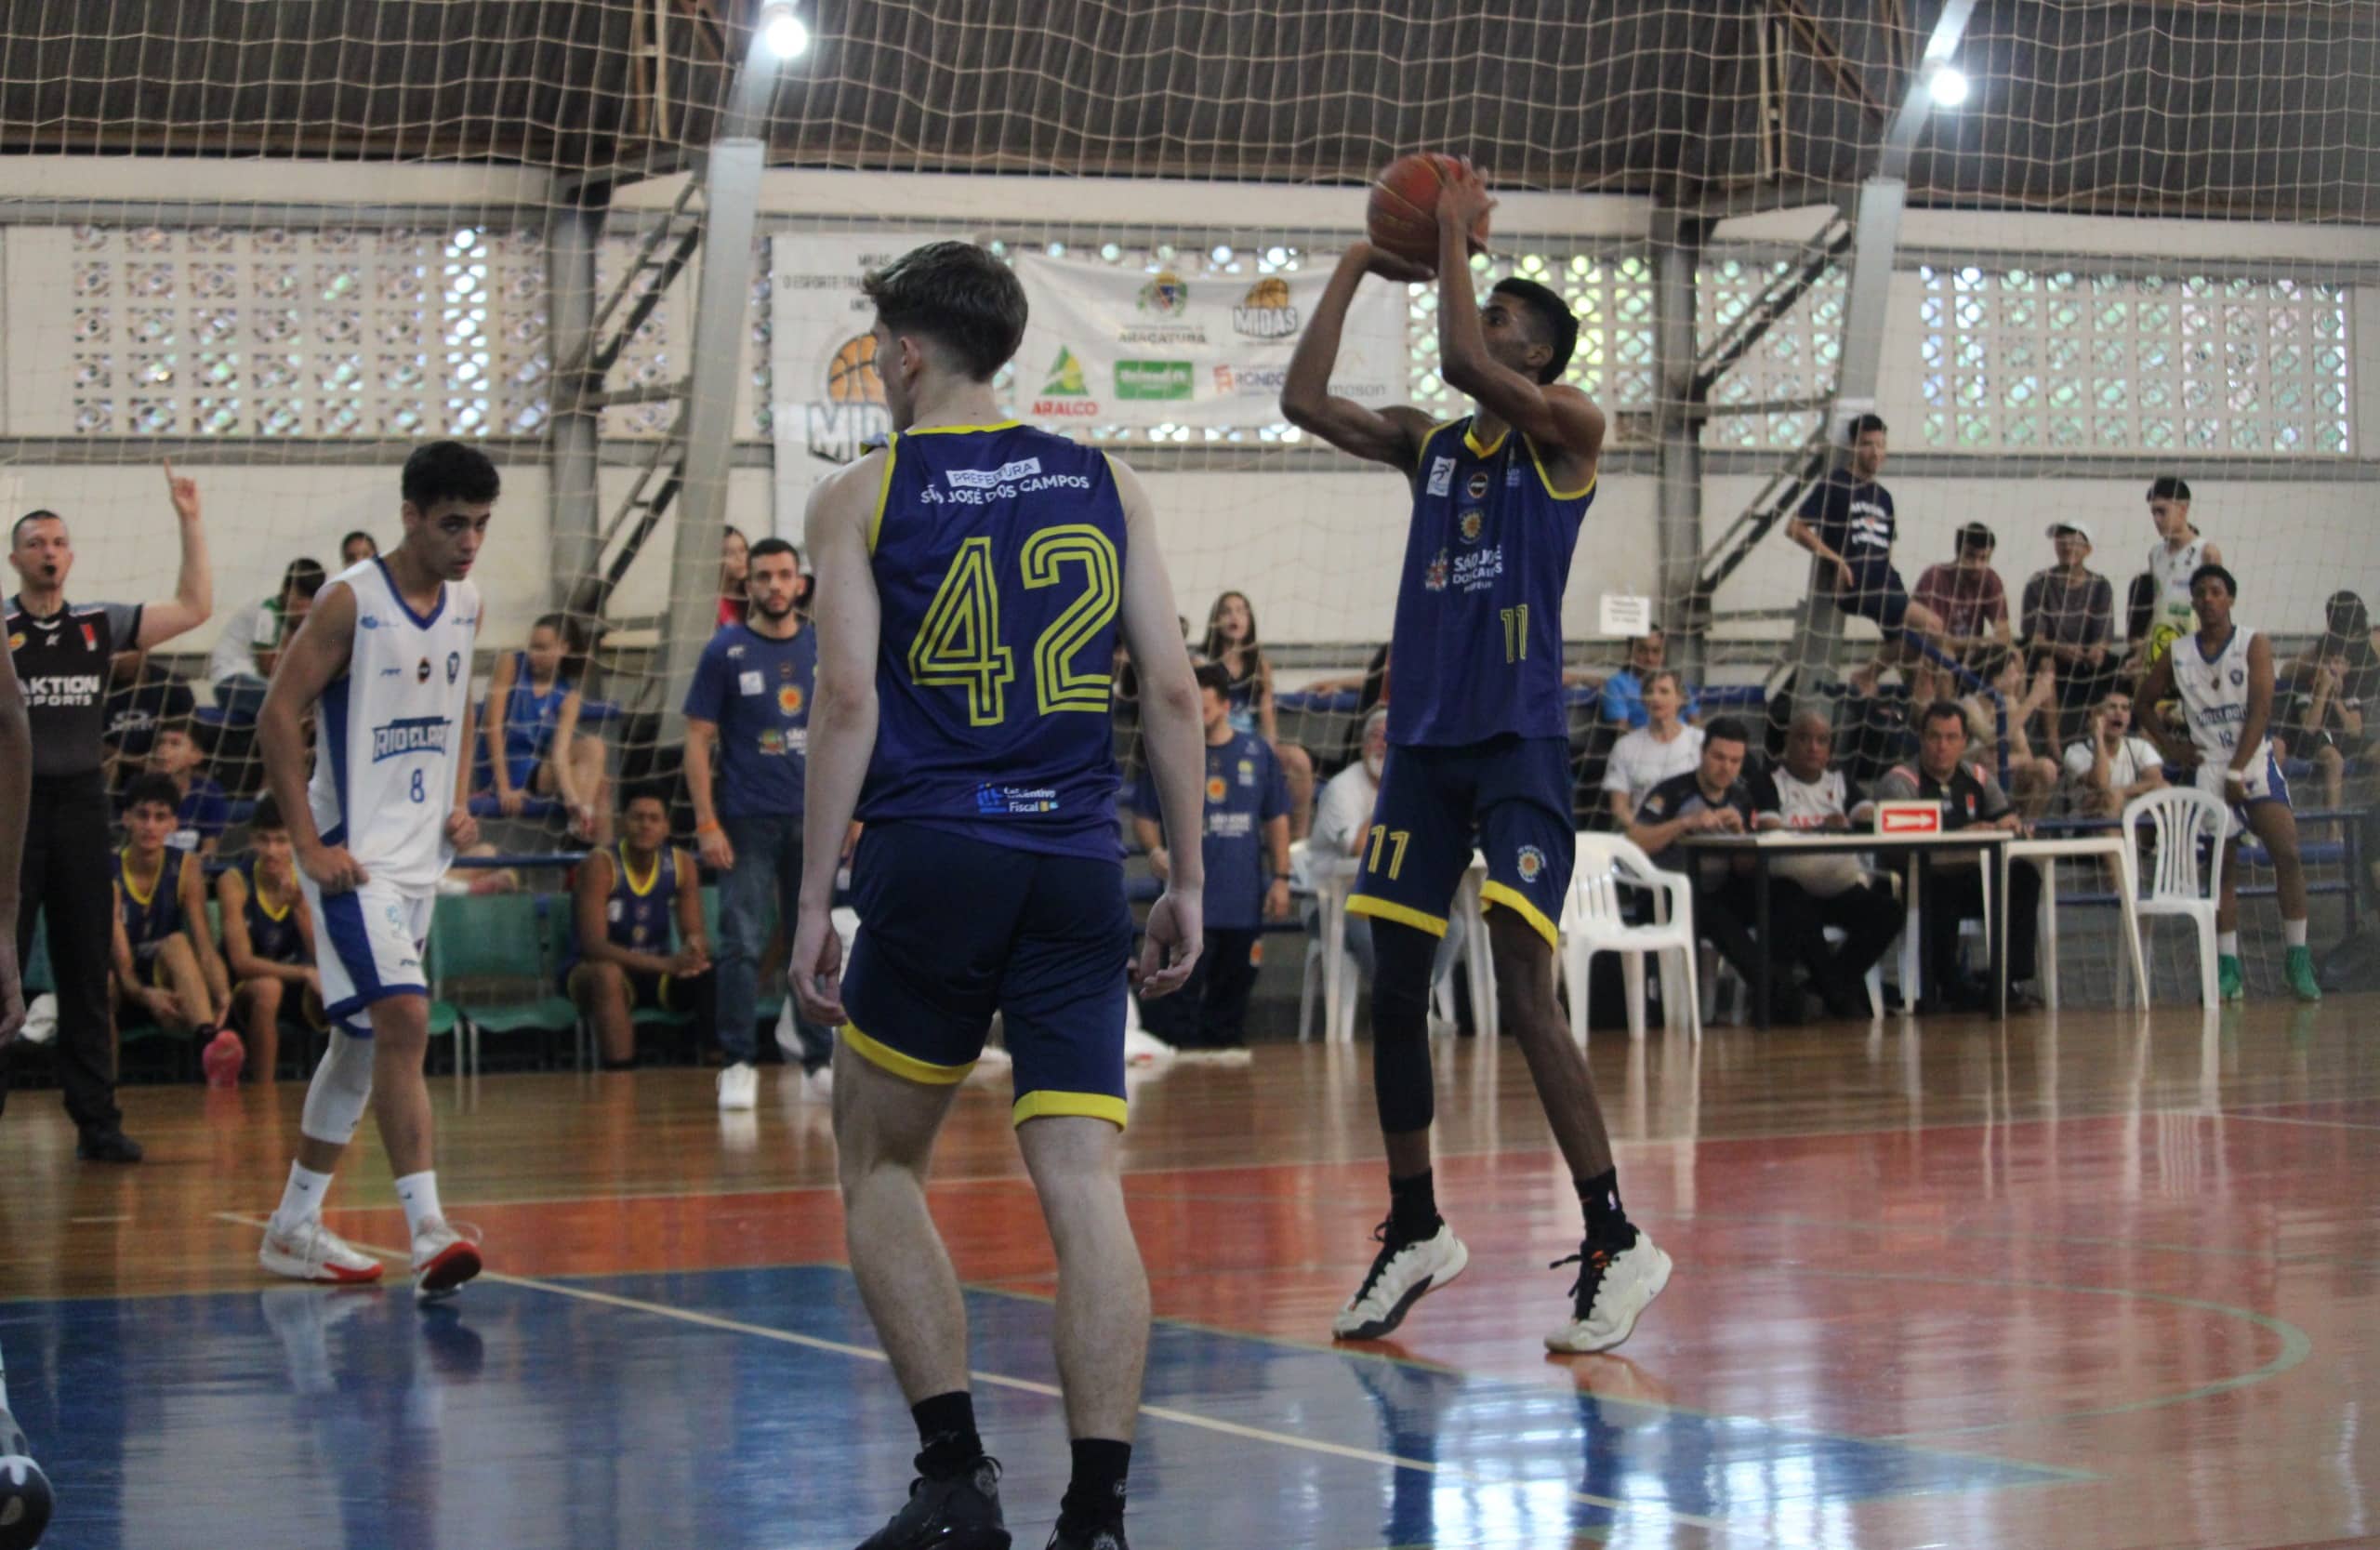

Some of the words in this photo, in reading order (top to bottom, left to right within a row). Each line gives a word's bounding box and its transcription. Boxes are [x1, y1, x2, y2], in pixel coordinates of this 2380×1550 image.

[1234, 307, 1298, 338] MIDAS
[1031, 401, 1099, 417] ARALCO
[805, 402, 893, 466] MID
[948, 488, 984, 505] JOSÉ
[1019, 474, 1091, 493] CAMPOS
[952, 463, 1035, 486] PREFEITURA
[908, 523, 1120, 727] 42
[1500, 603, 1529, 664] 11
[410, 768, 425, 803] 8
[1009, 801, 1038, 812] Fiscal
[1368, 824, 1410, 881] 11
